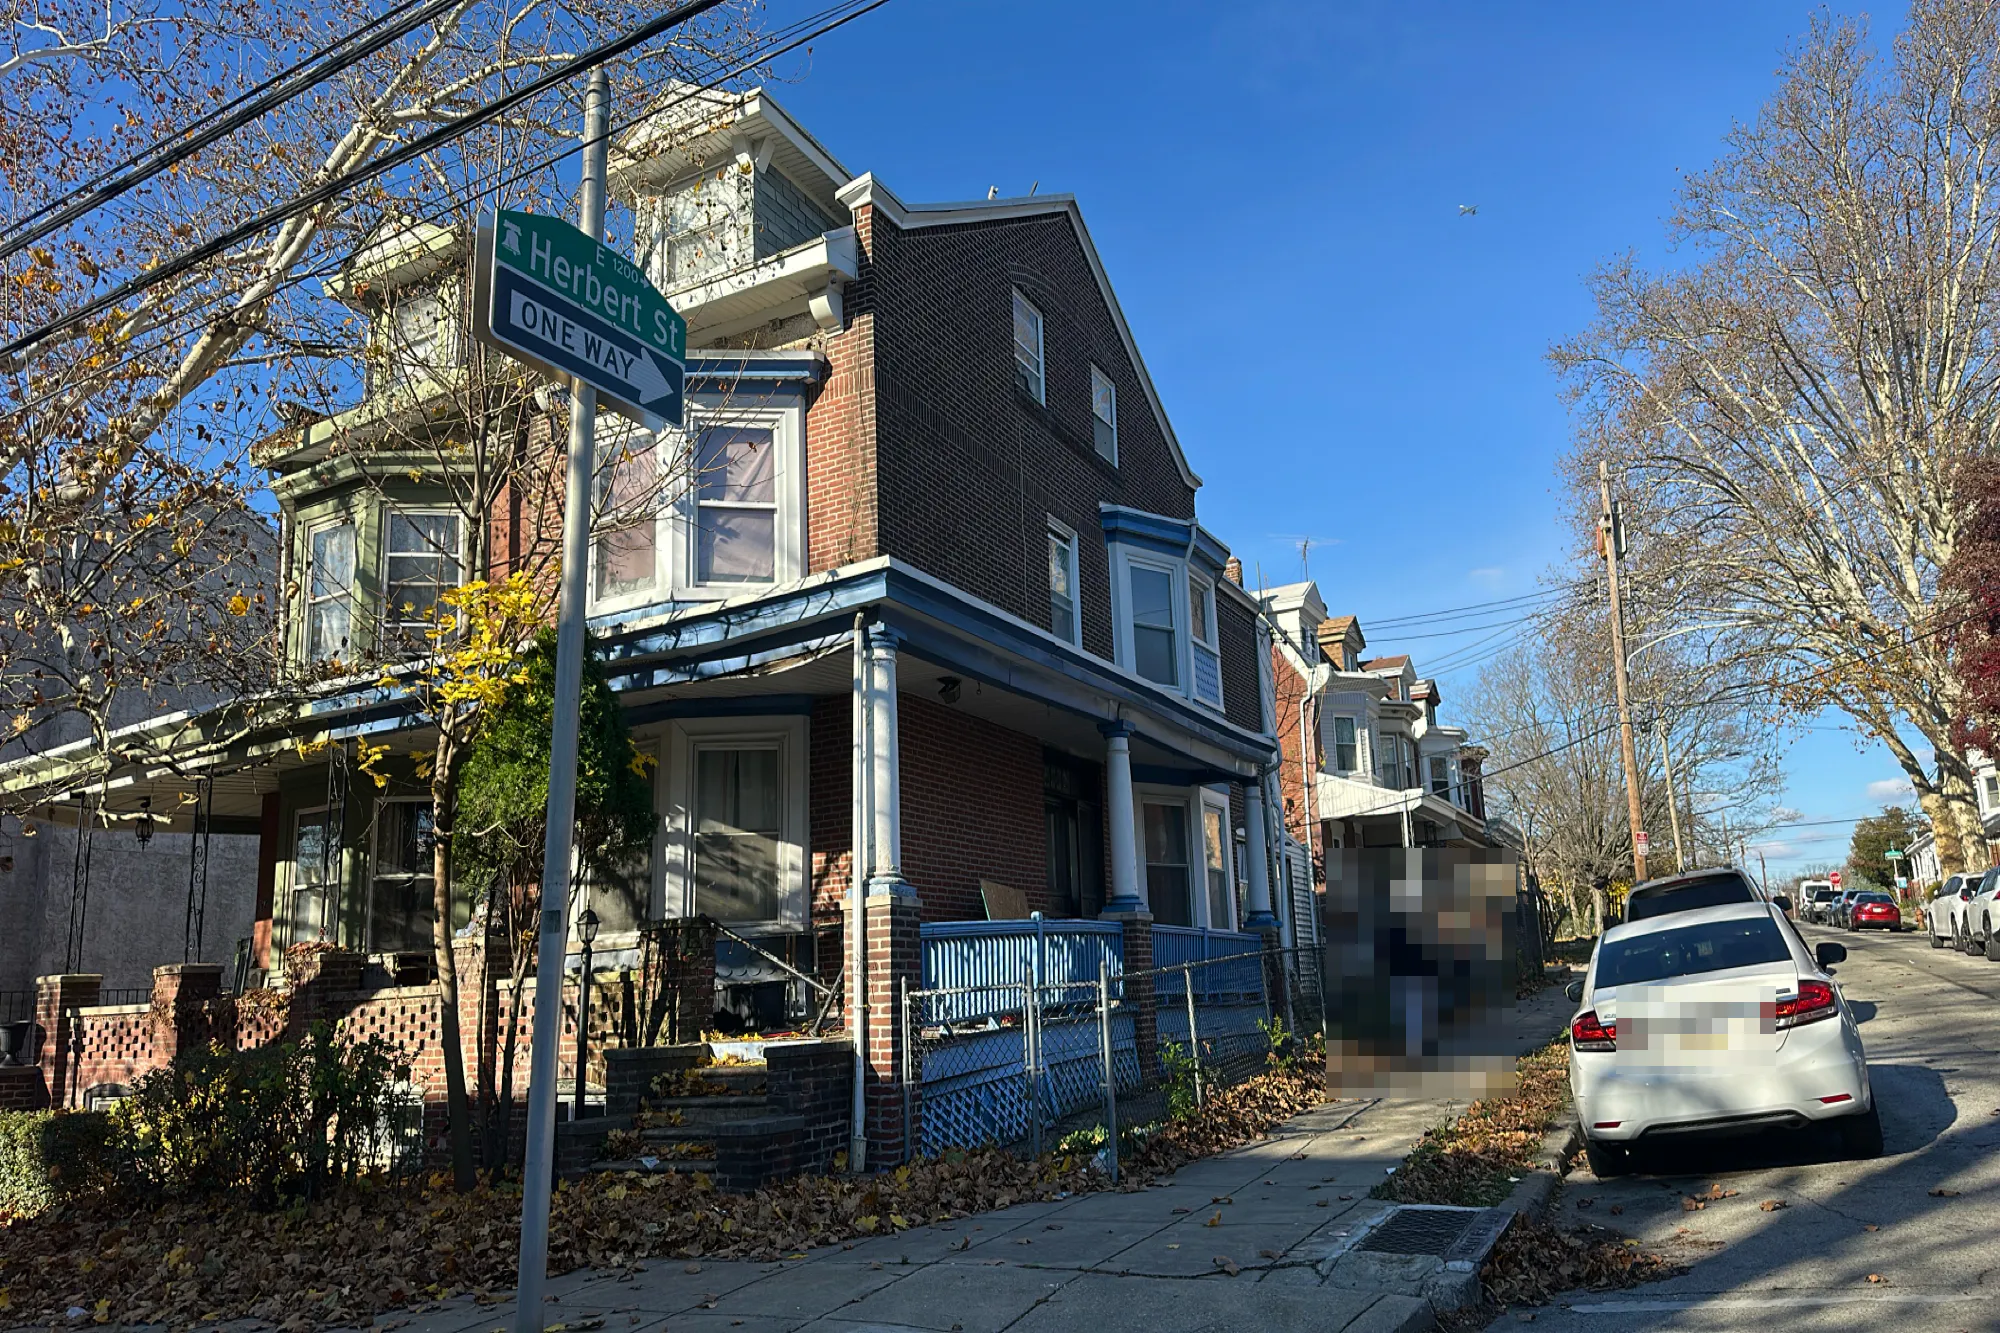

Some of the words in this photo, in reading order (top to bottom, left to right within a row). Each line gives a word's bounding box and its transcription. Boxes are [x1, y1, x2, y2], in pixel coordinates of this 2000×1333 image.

[530, 230, 642, 332] Herbert
[653, 308, 679, 353] St
[596, 245, 605, 267] E
[613, 257, 639, 284] 1200
[521, 301, 575, 352] ONE
[583, 332, 635, 379] WAY
